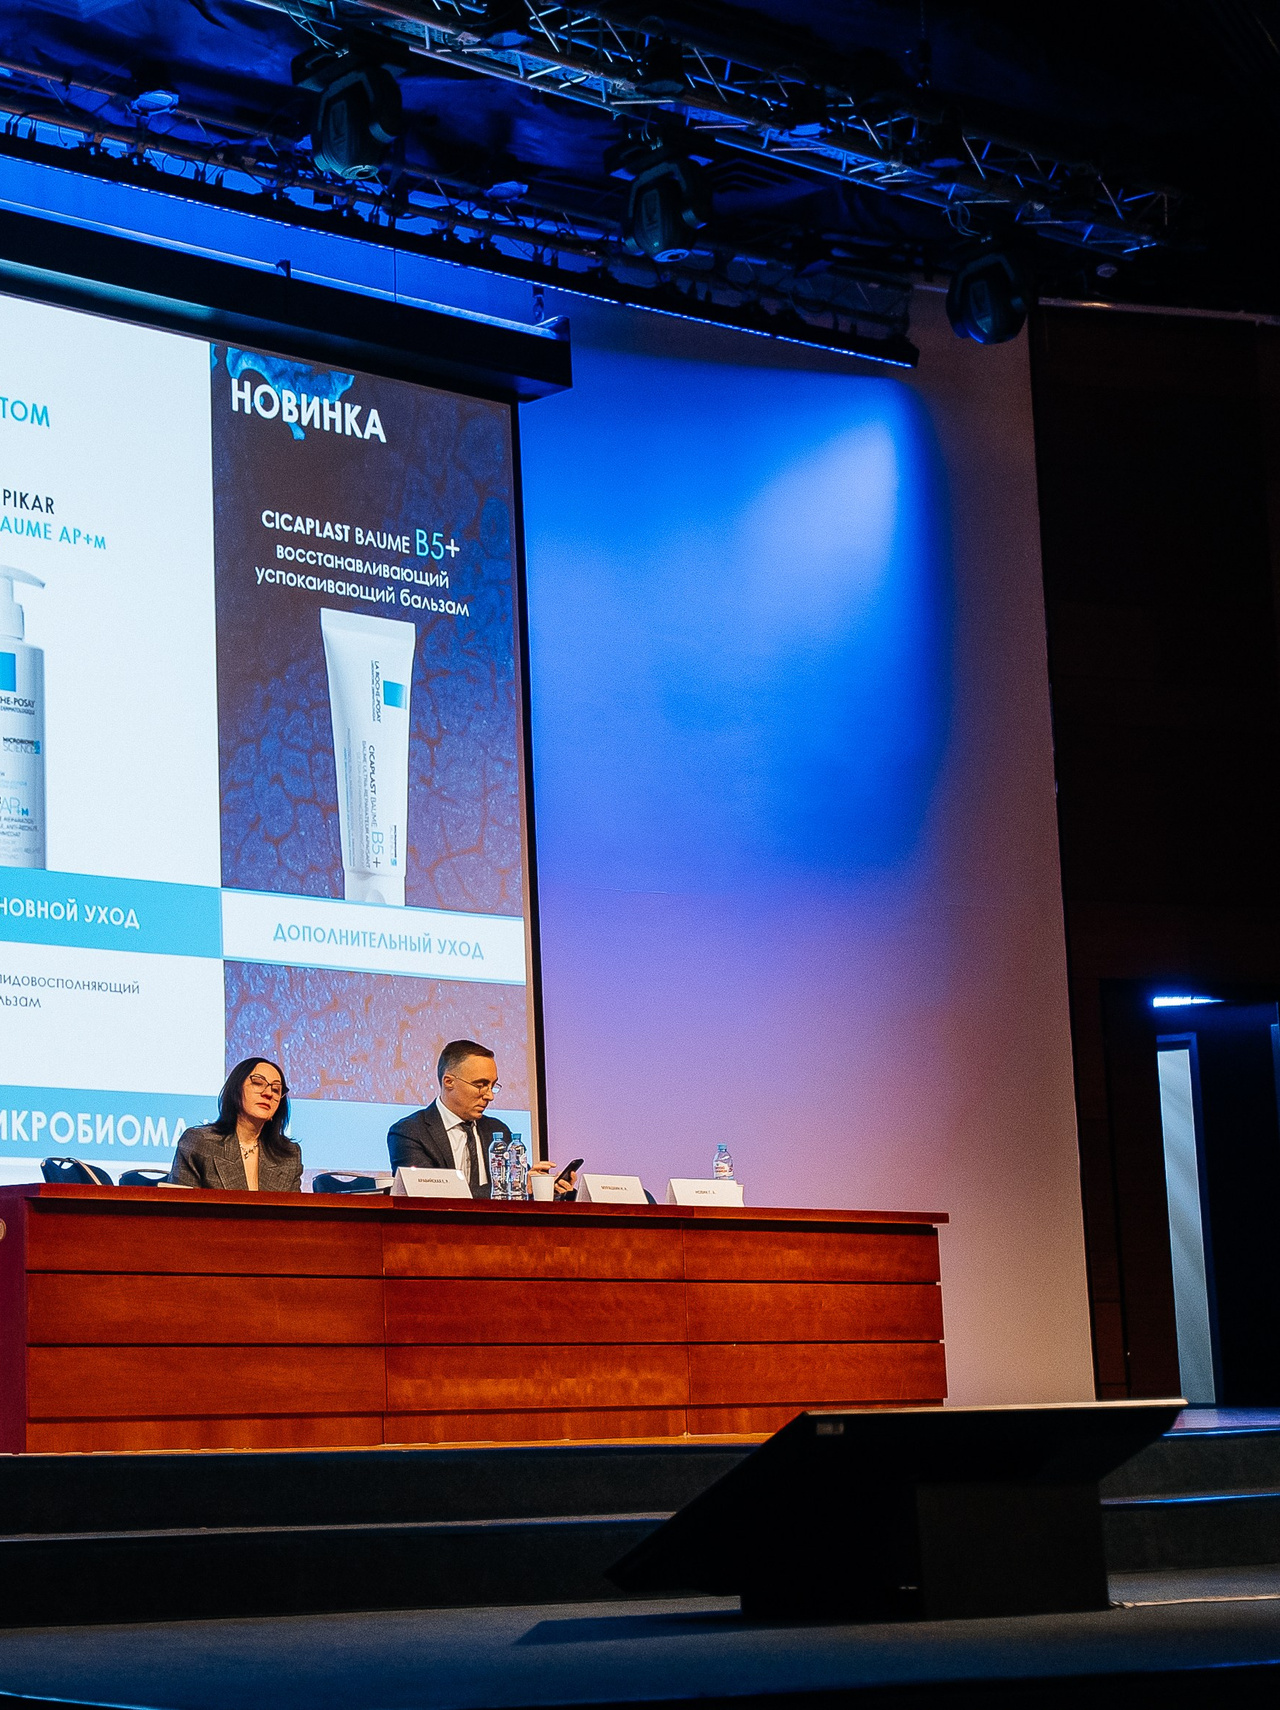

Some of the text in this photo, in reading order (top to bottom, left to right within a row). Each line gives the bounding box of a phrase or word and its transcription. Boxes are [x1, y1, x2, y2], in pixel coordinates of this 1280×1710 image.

[231, 378, 387, 443] НОВИНКА
[261, 510, 460, 560] CICAPLAST BAUME B5+
[276, 545, 449, 588] восстанавливающий
[255, 566, 470, 617] успокаивающий бальзам
[369, 745, 377, 794] CICAPLAST
[371, 831, 384, 868] B5+
[84, 904, 140, 930] УХОД
[273, 922, 484, 961] ДОПОЛНИТЕЛЬНЫЙ УХОД
